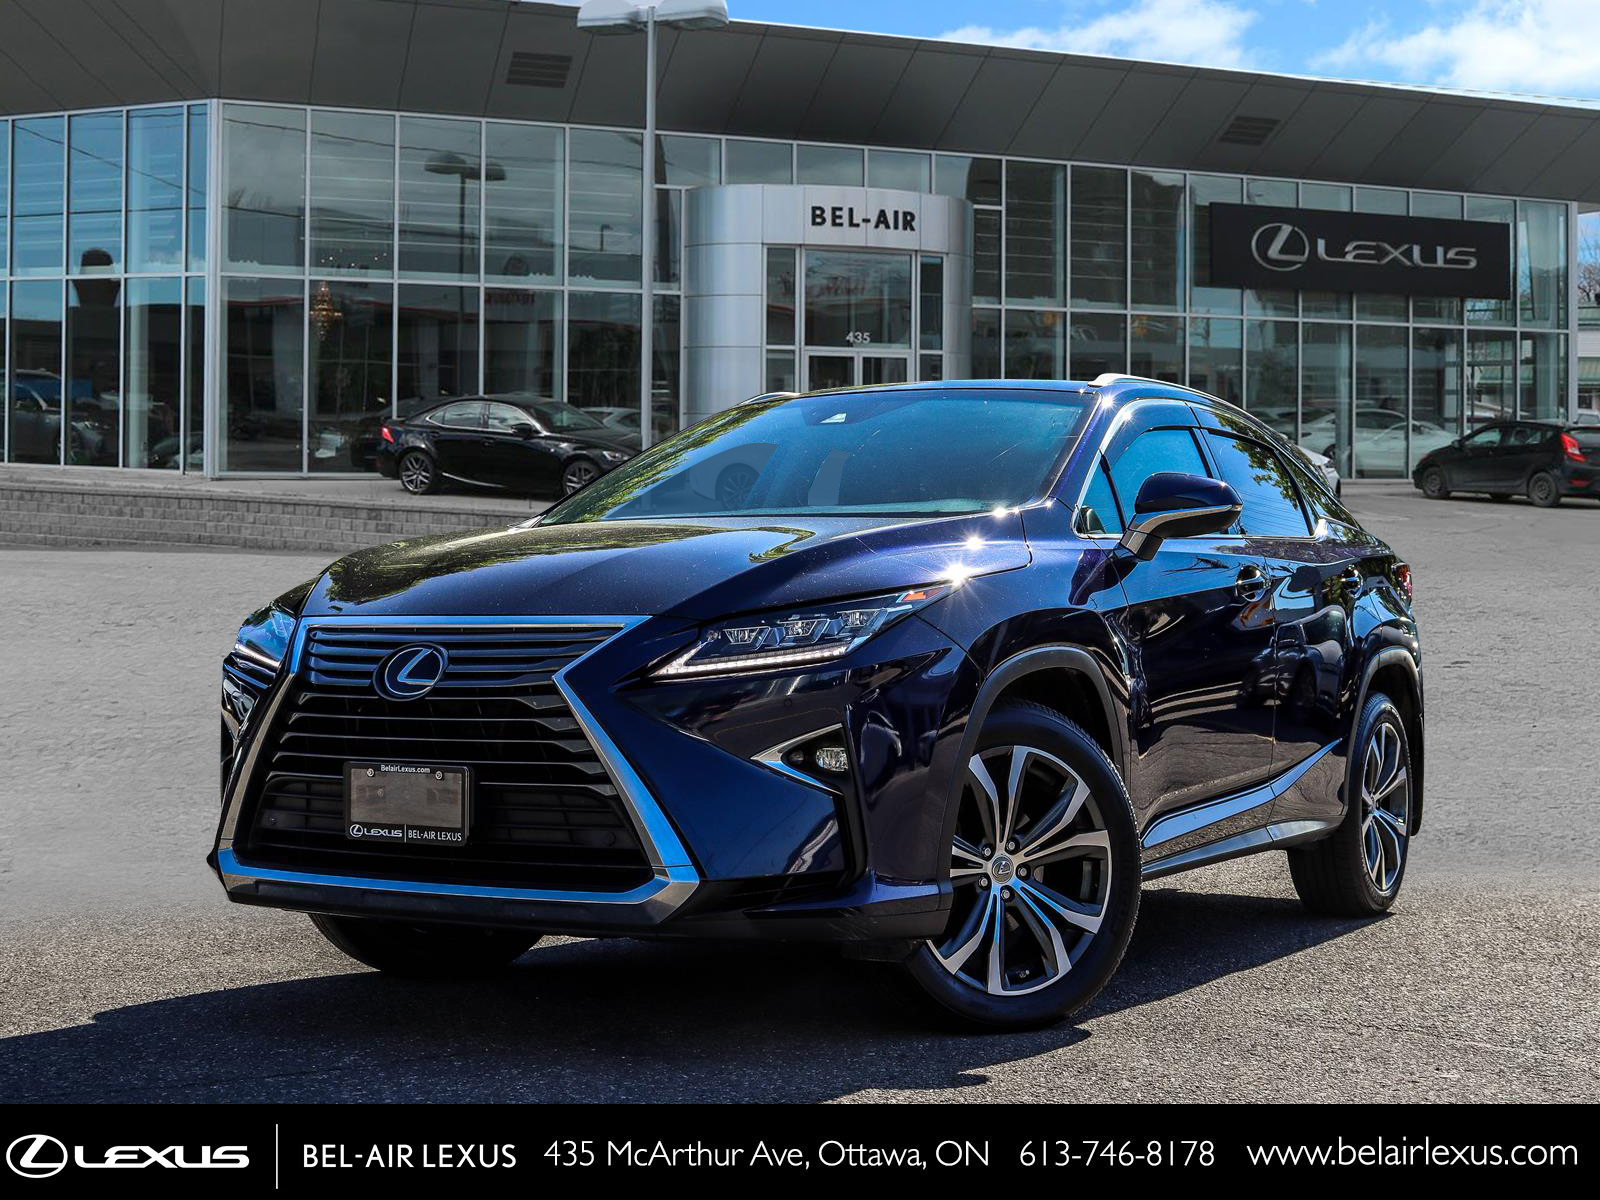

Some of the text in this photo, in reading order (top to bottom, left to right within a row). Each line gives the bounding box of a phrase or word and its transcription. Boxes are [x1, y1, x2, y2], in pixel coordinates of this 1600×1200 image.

[811, 205, 916, 232] BEL-AIR
[1317, 238, 1478, 269] LEXUS
[845, 331, 871, 344] 435
[380, 764, 431, 774] BelairLexus.com
[364, 828, 403, 838] LEXUS
[408, 830, 462, 842] BEL-AIR LEXUS
